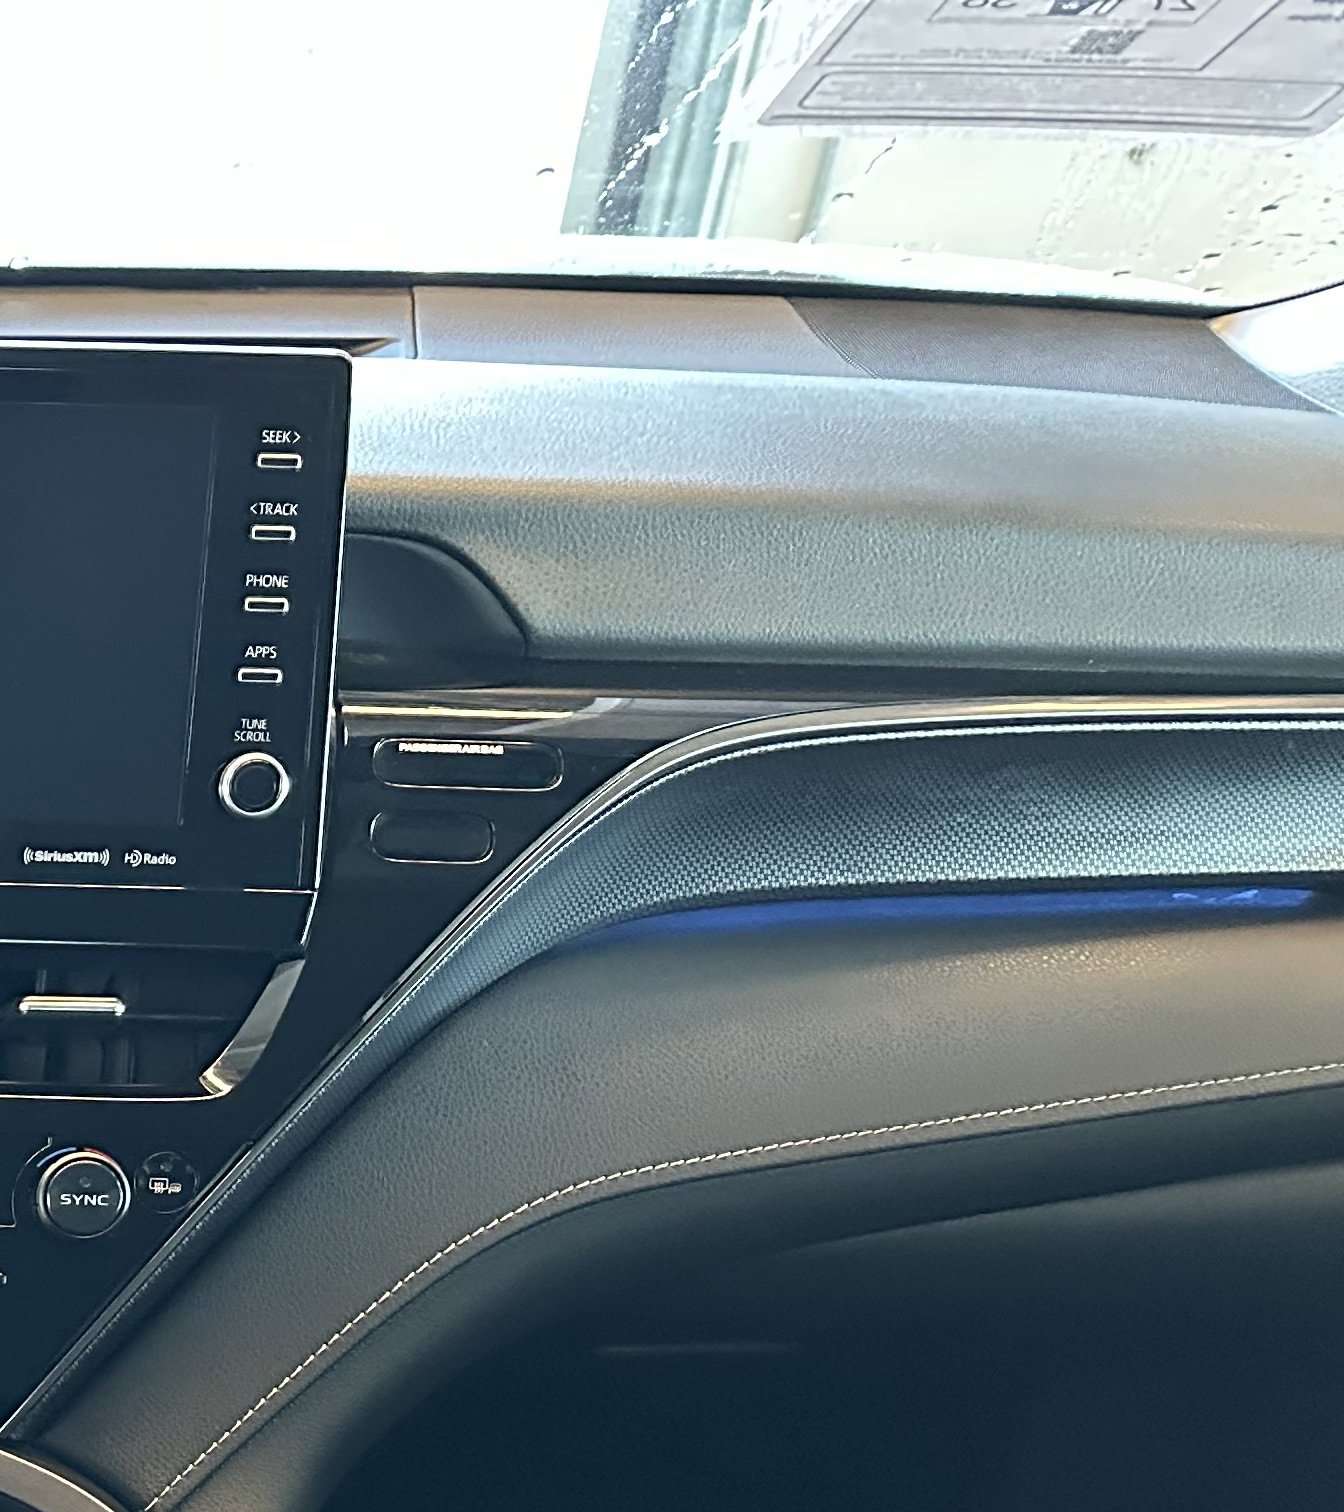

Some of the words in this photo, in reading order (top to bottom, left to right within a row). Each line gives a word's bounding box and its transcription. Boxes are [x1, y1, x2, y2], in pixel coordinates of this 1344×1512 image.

[245, 574, 290, 588] PHONE
[244, 645, 278, 660] APPS
[240, 717, 268, 730] TUNE
[233, 730, 272, 743] SCROLL
[143, 853, 177, 865] Radio
[59, 1192, 109, 1208] SYNC
